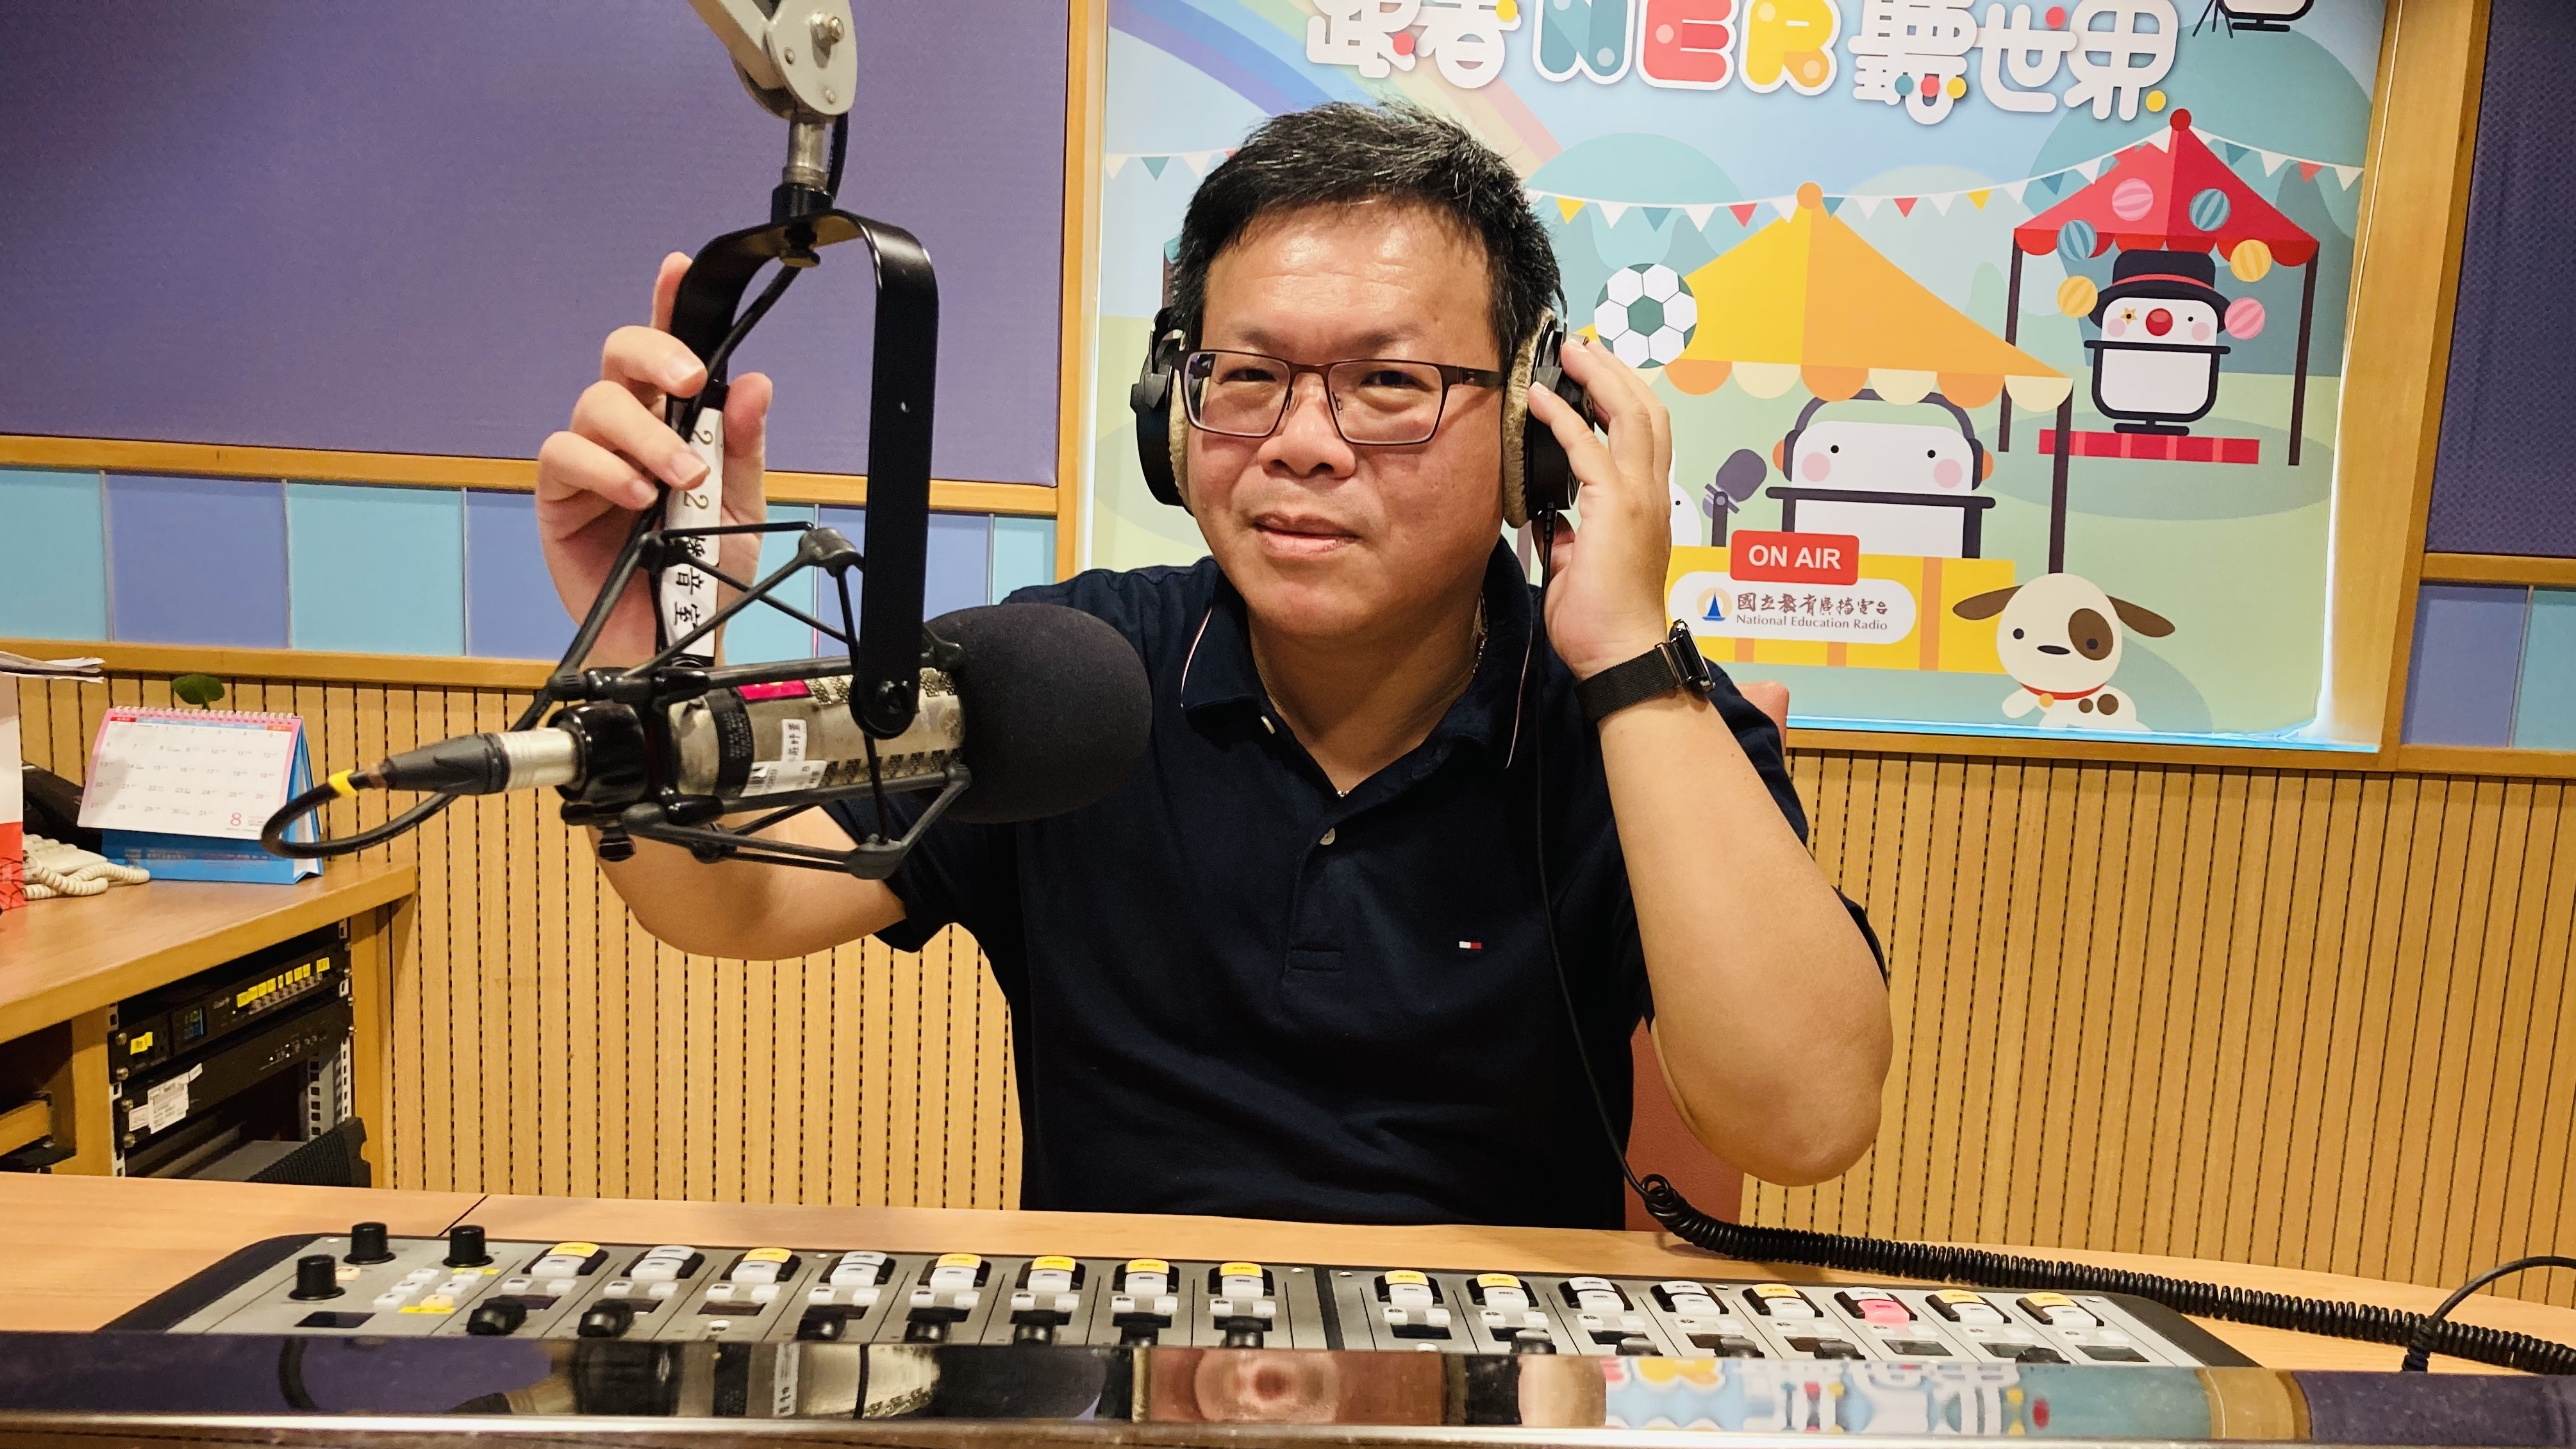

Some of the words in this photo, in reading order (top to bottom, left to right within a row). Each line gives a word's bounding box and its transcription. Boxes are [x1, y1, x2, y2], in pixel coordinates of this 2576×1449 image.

[1749, 544, 1788, 567] ON
[1794, 547, 1841, 569] AIR
[1738, 592, 1888, 616] 國立教育廣播電台
[1736, 614, 1786, 626] National
[1791, 616, 1849, 628] Education
[1854, 619, 1888, 630] Radio
[230, 812, 242, 826] 8
